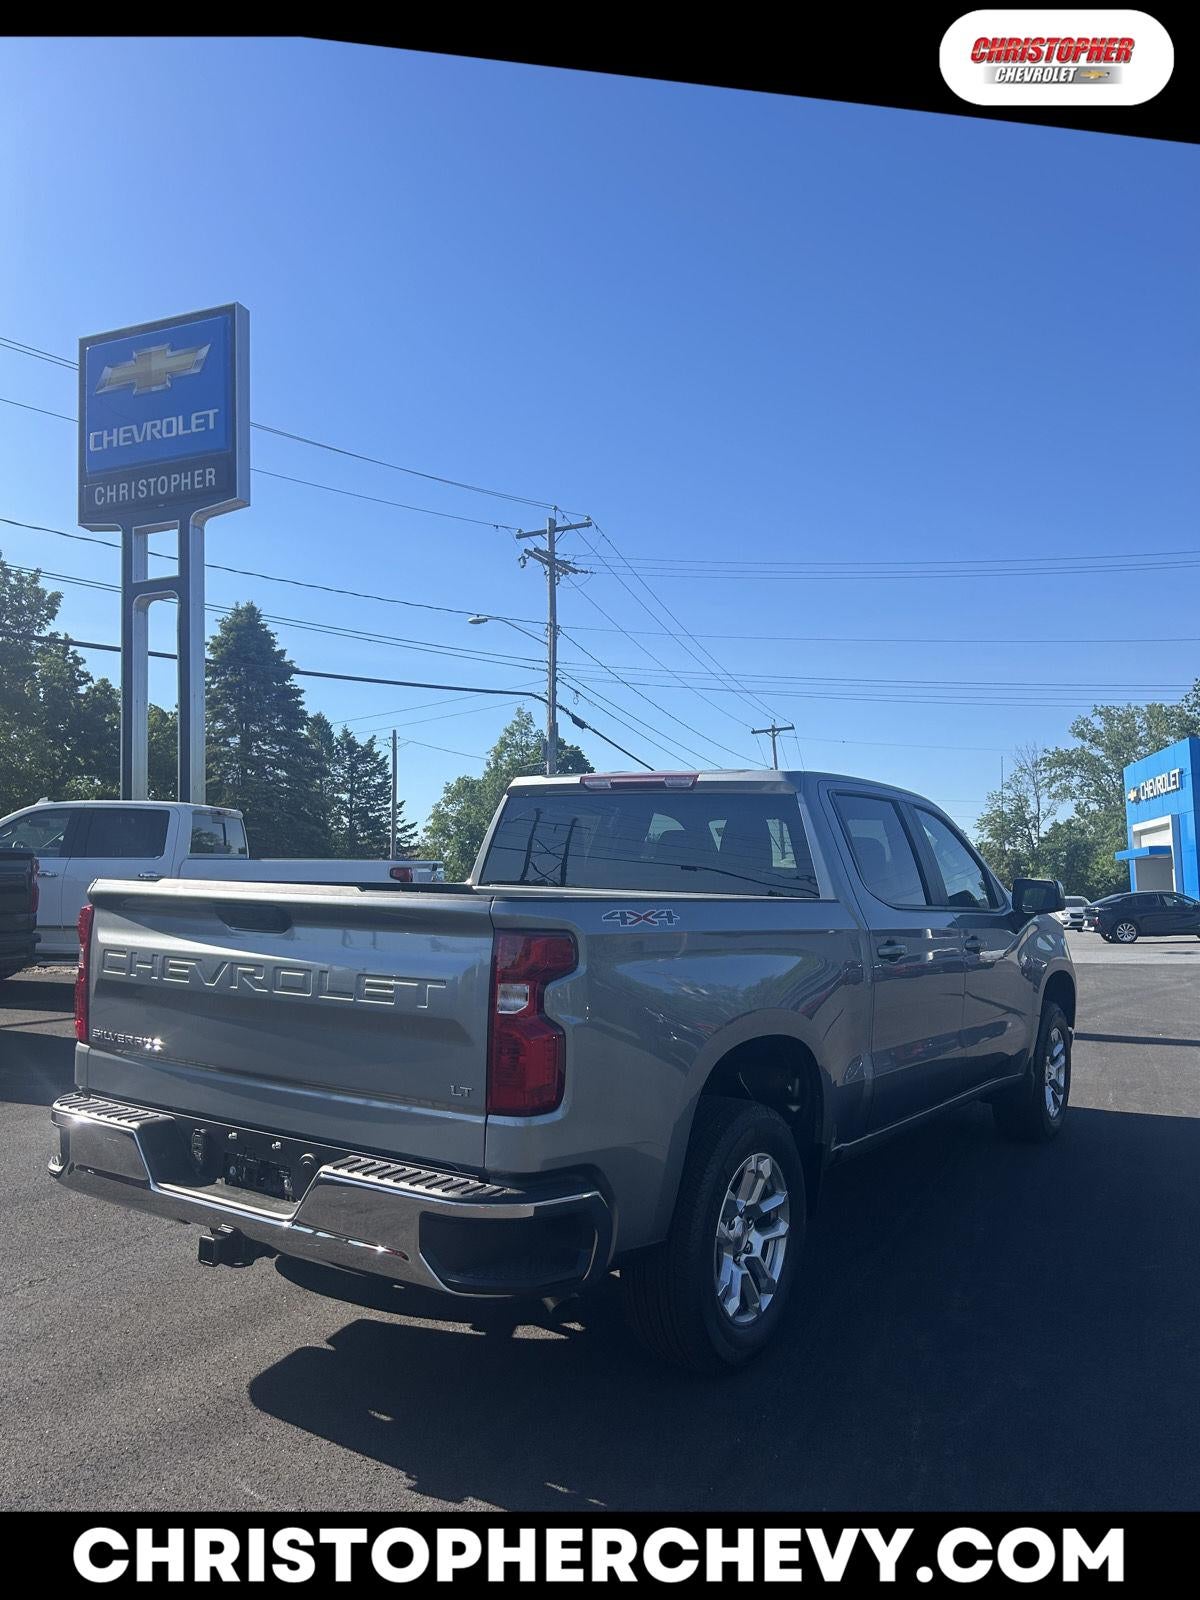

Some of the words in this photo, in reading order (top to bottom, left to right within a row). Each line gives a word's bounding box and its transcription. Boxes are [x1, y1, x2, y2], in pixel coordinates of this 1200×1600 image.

[89, 409, 219, 452] CHEVROLET
[94, 467, 216, 506] CHRISTOPHER
[1139, 769, 1180, 801] CHEVROLET
[102, 948, 447, 1010] CHEVROLET
[92, 1028, 164, 1052] SILVERA
[449, 1083, 473, 1098] LT
